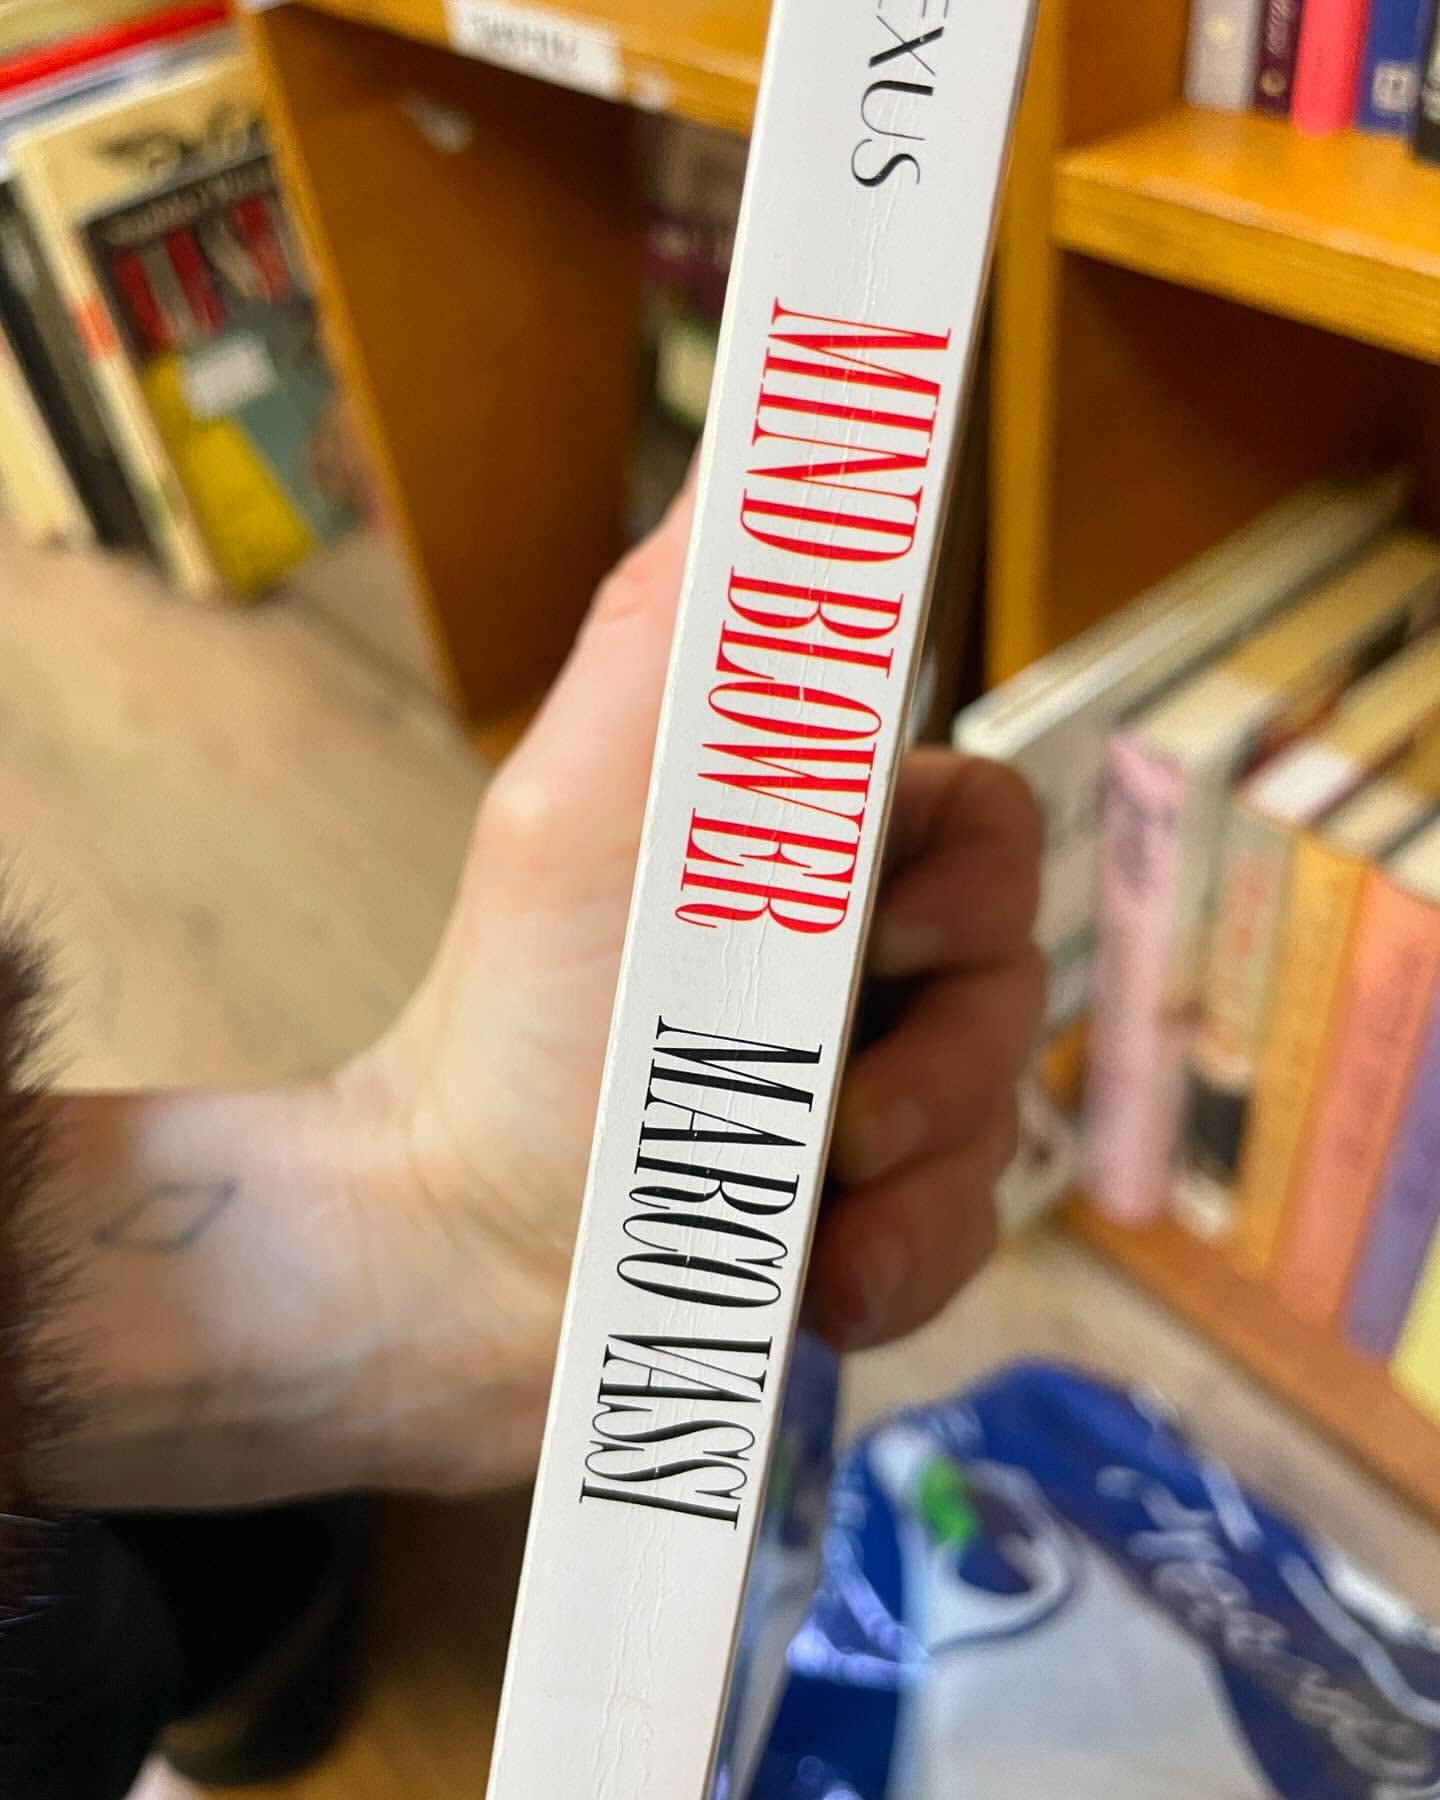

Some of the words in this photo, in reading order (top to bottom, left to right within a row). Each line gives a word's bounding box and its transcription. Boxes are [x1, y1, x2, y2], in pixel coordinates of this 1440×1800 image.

[739, 297, 952, 564] MIND
[674, 566, 904, 935] BLOWER
[616, 1014, 822, 1308] MARCO
[579, 1333, 773, 1531] VASSI
